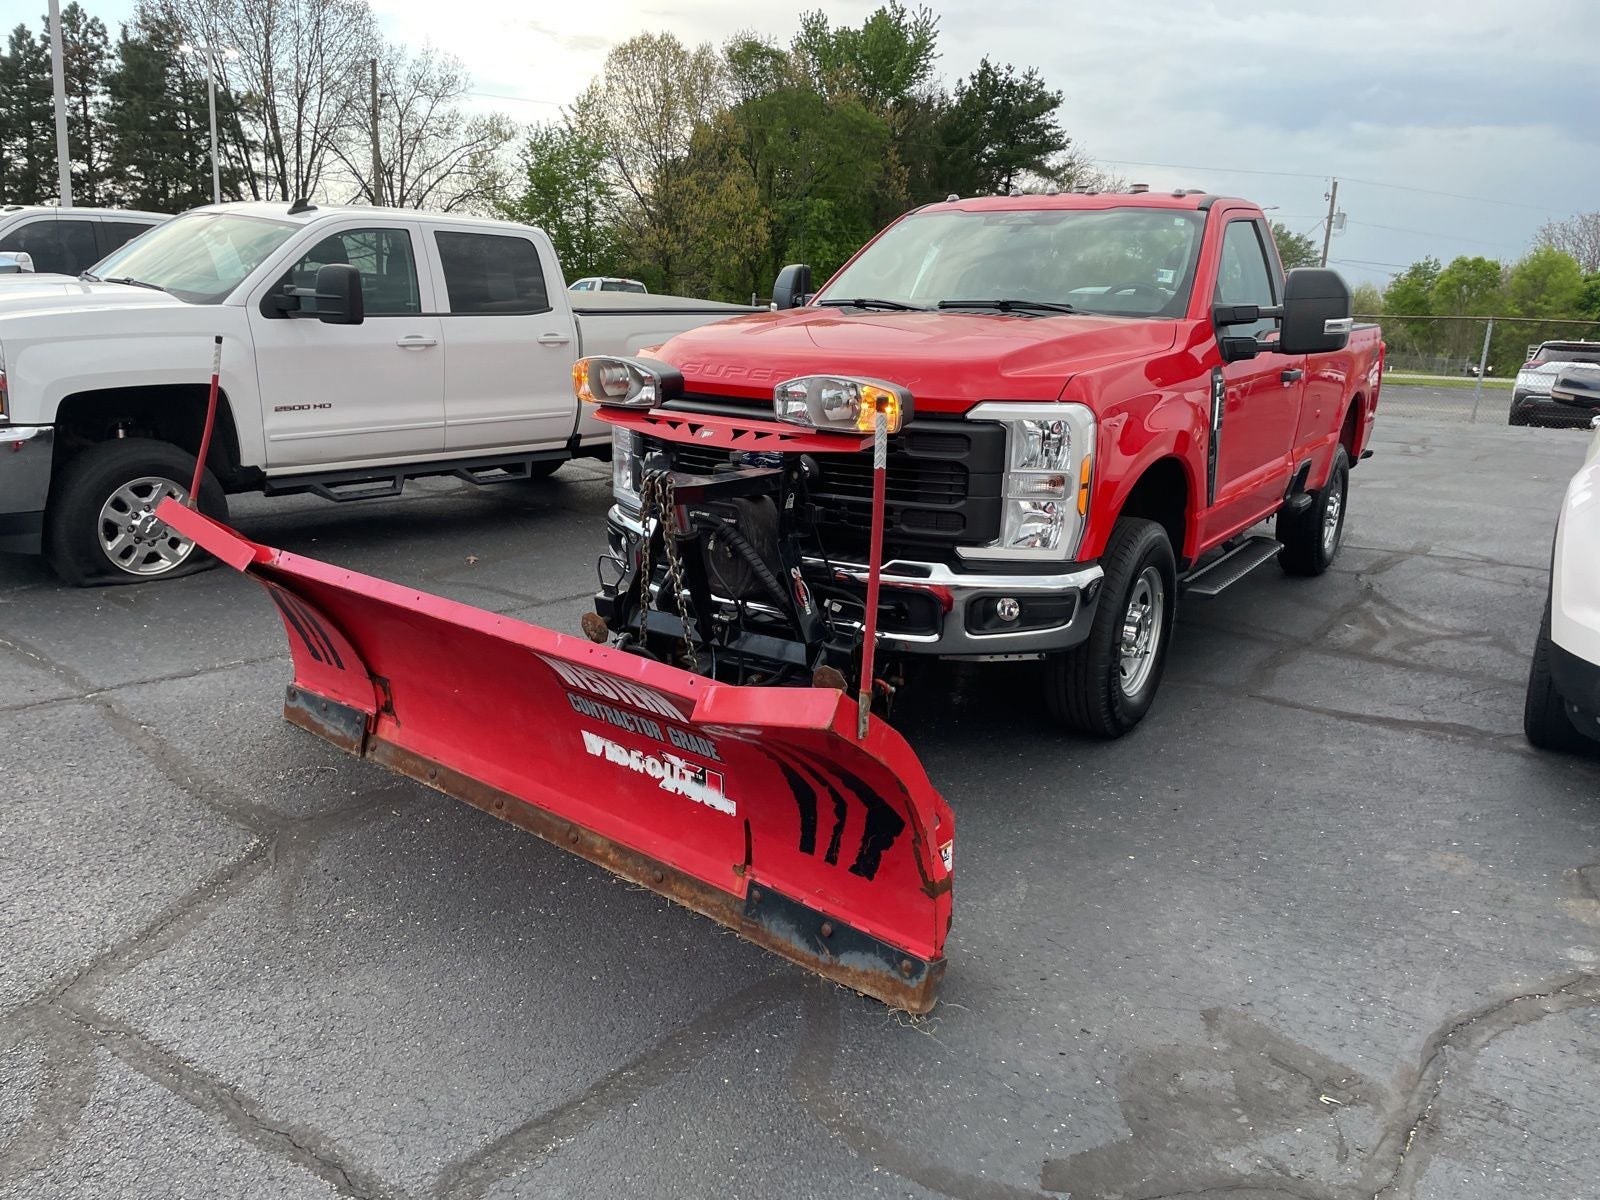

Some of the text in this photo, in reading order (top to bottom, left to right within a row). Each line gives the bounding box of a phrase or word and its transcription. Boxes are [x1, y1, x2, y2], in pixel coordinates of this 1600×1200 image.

[274, 404, 310, 412] 2500
[534, 652, 690, 724] WESTERN
[567, 692, 721, 760] CONTRACTOR GRADE
